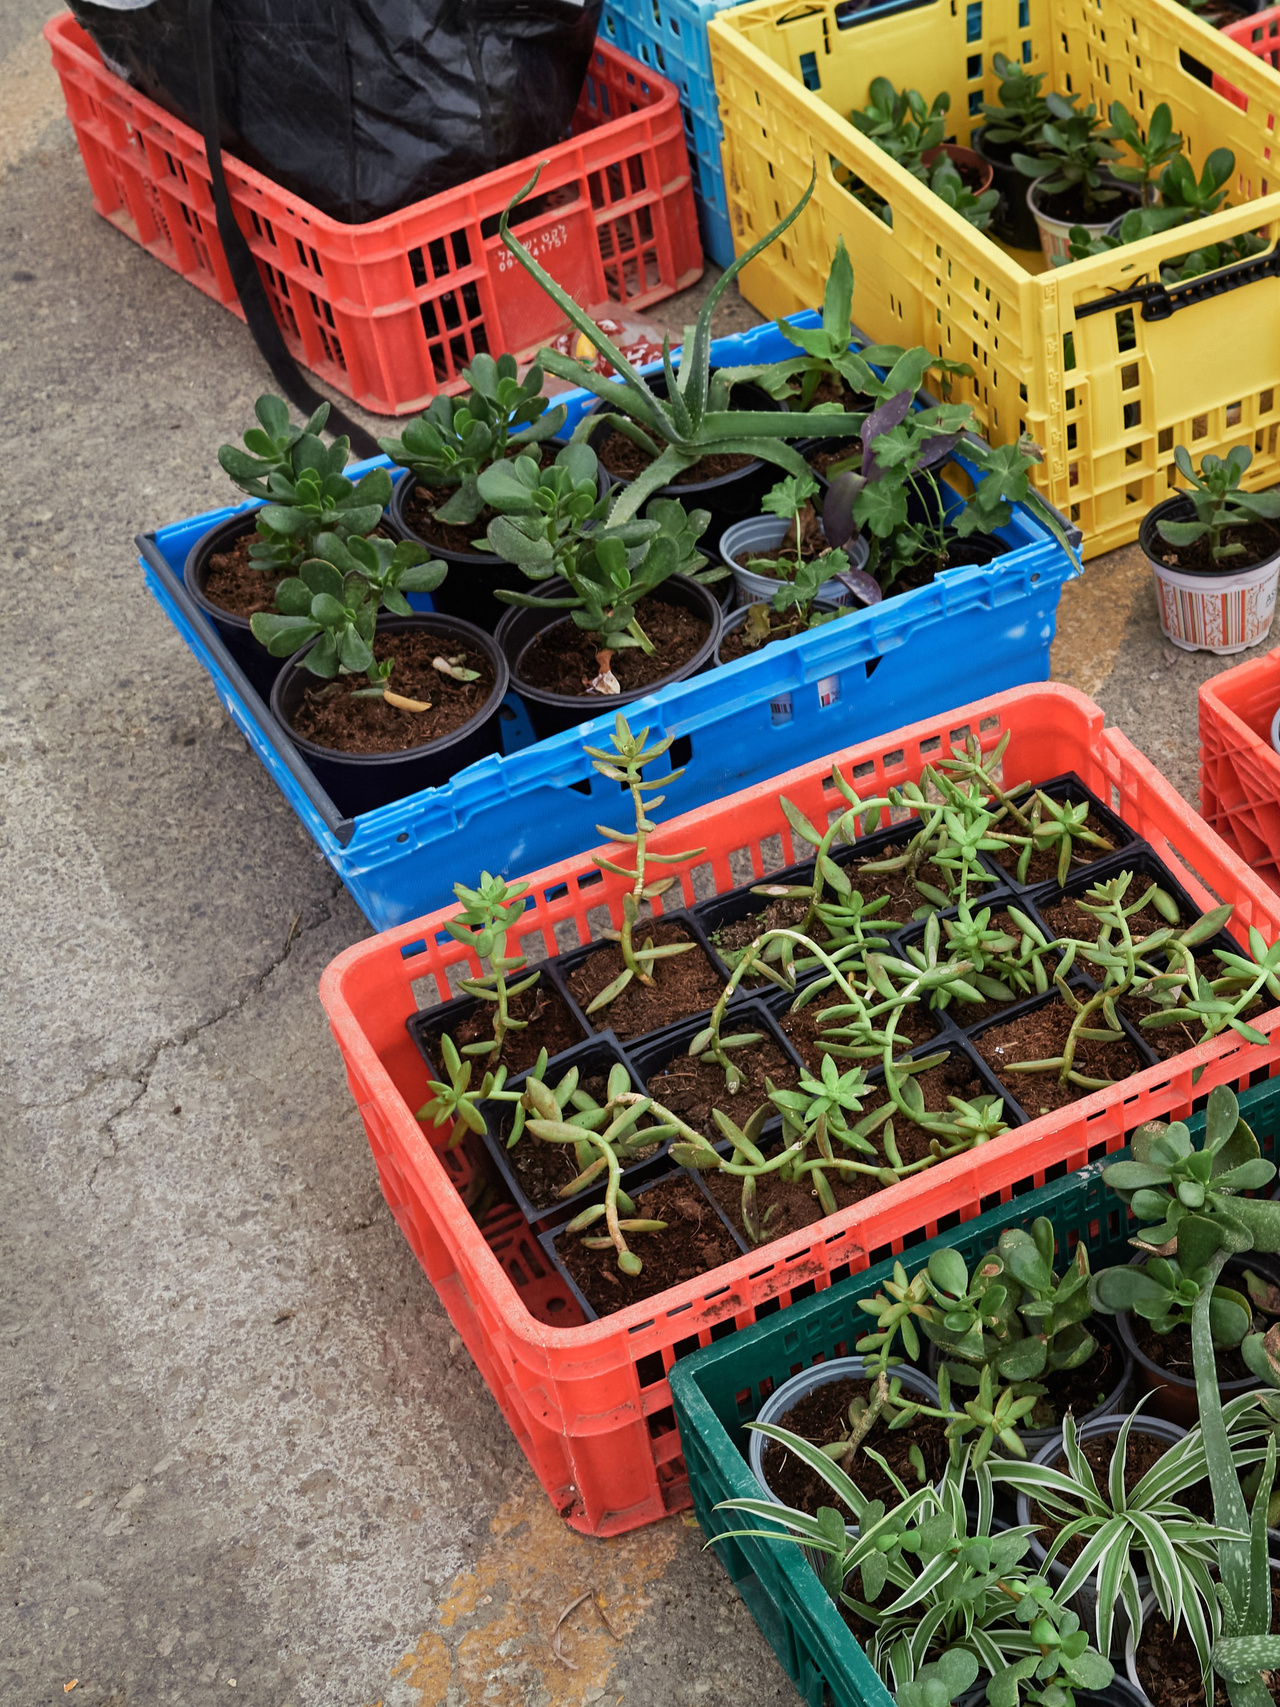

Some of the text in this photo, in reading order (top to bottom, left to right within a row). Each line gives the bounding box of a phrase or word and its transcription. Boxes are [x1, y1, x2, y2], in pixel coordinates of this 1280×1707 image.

[498, 225, 566, 261] לקט ישאל
[499, 234, 568, 272] 09-41757
